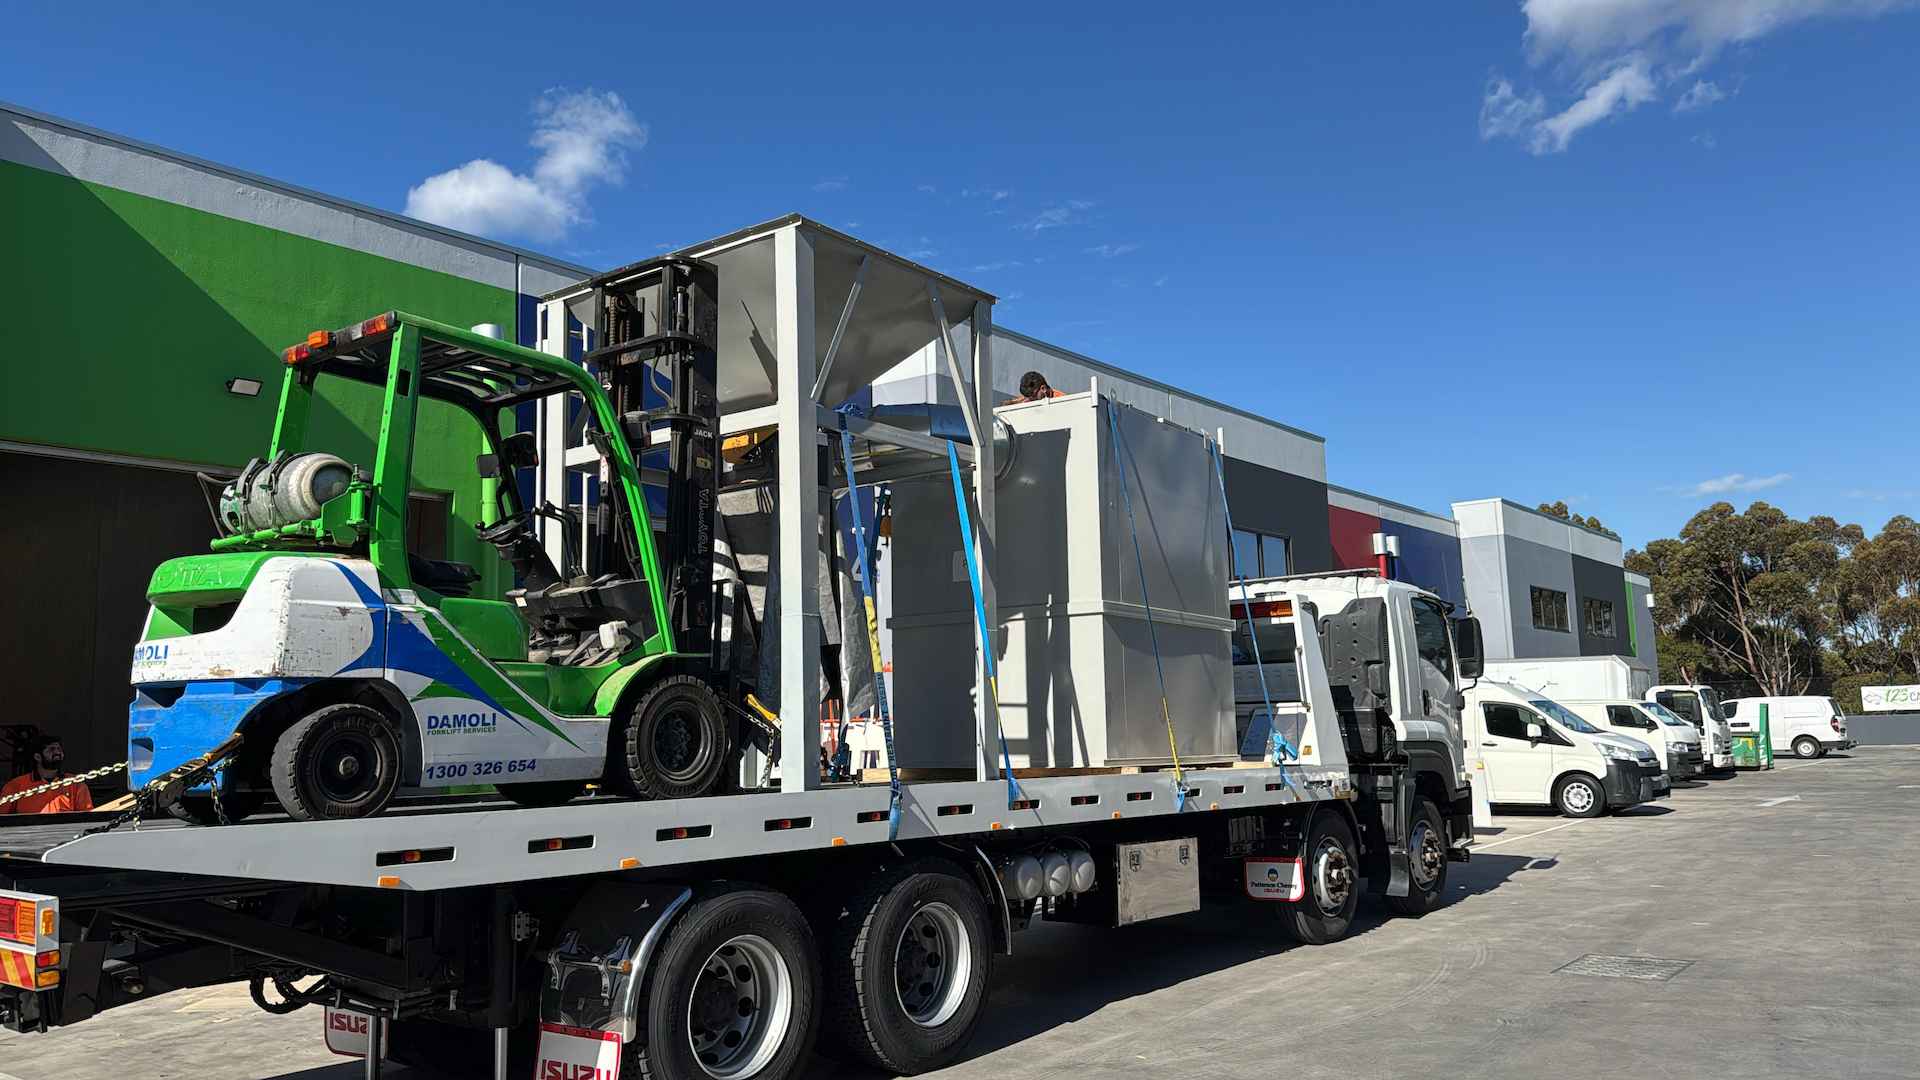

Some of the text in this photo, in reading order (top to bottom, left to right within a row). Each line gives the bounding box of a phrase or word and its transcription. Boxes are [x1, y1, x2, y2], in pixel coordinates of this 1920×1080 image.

[694, 428, 713, 439] JACK
[427, 712, 497, 730] DAMOLI
[463, 726, 497, 735] SERVICES
[426, 759, 537, 779] 1300 326 654
[330, 1012, 367, 1035] ISUZ
